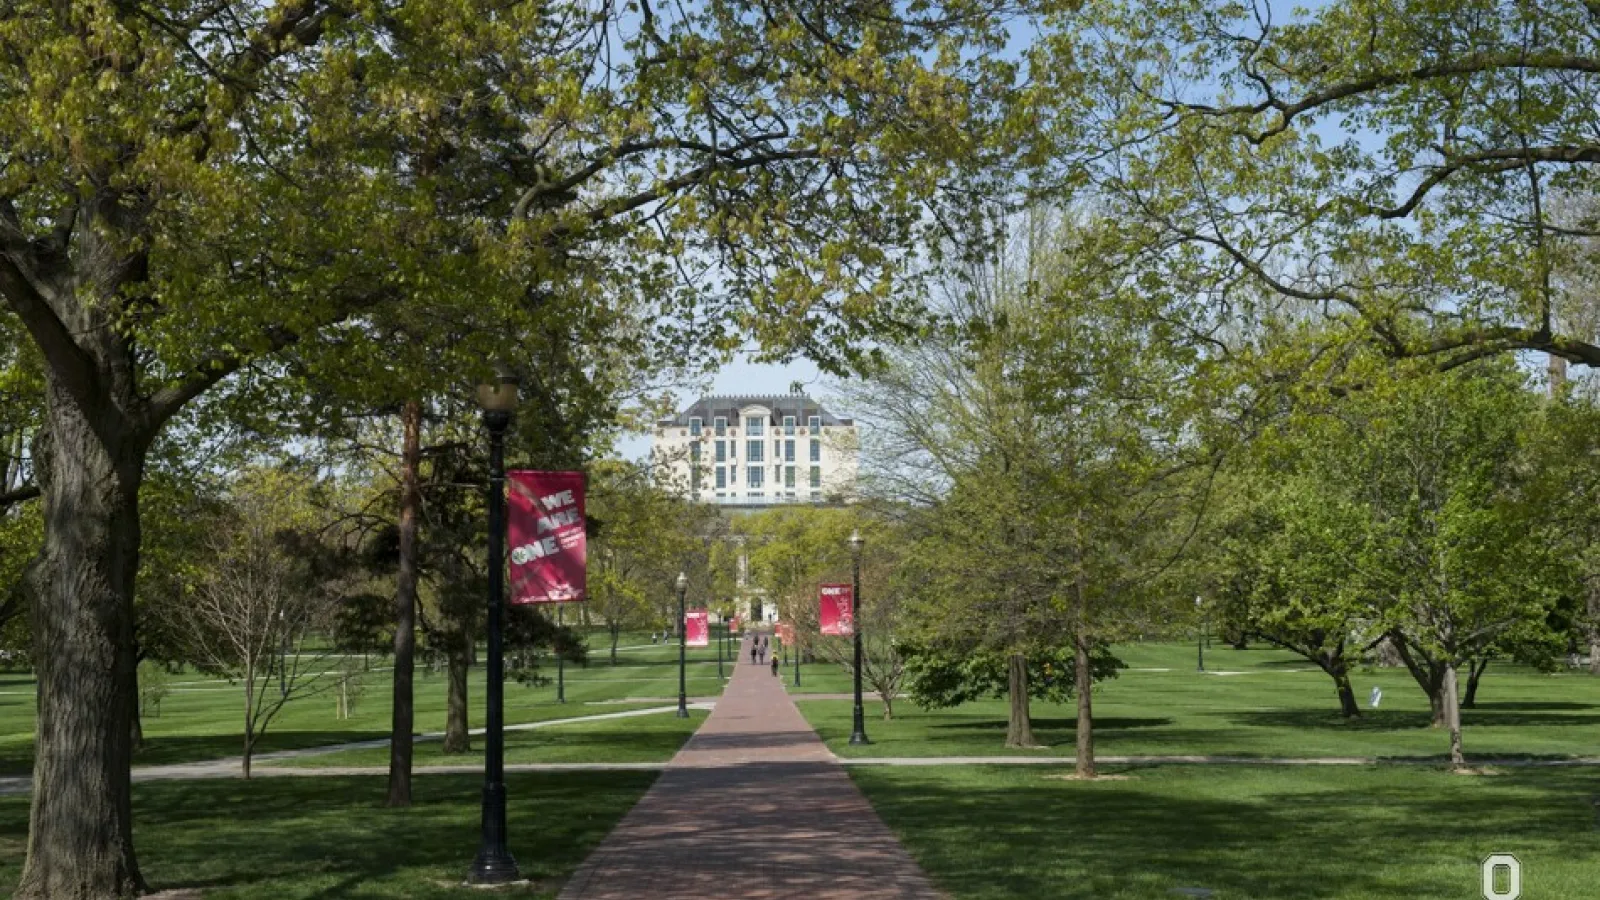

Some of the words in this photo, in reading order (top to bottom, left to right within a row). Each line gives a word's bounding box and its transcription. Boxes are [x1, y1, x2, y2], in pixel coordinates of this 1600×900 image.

[541, 489, 575, 510] WE
[537, 507, 581, 535] ARE
[512, 536, 559, 564] ONE
